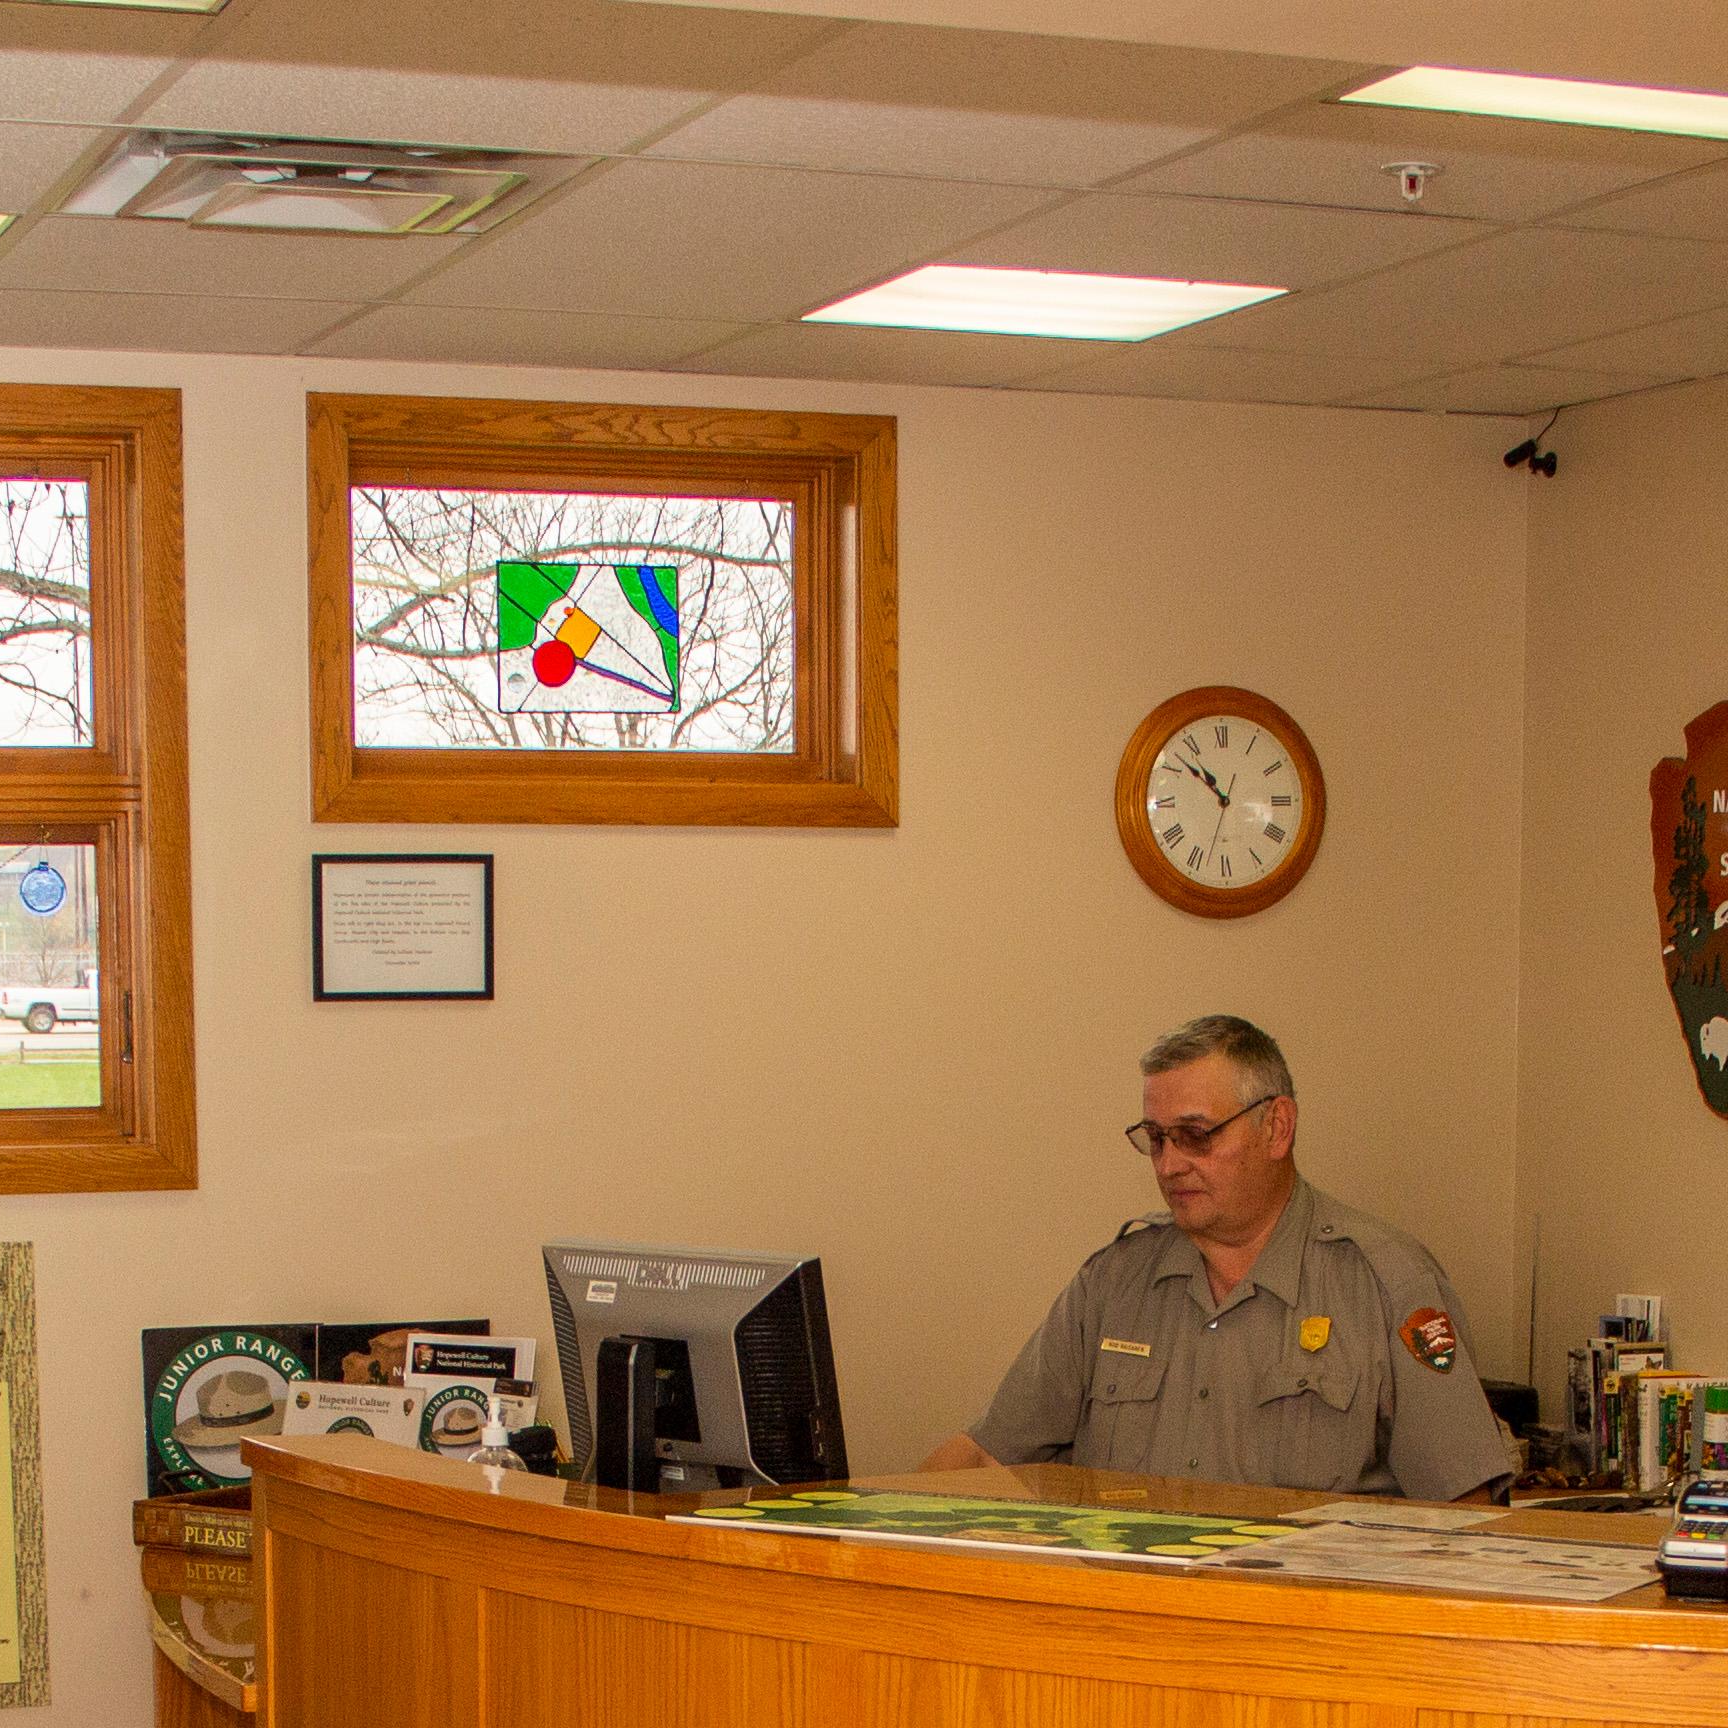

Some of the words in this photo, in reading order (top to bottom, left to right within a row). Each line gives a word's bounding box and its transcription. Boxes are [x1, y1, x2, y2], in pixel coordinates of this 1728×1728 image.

[159, 1337, 224, 1402] JUNIOR
[236, 1335, 306, 1381] RANGE
[319, 1394, 357, 1408] Hopewell
[360, 1398, 390, 1408] Culture
[425, 1387, 459, 1420] JUNIOR
[184, 1526, 246, 1549] PLEASE
